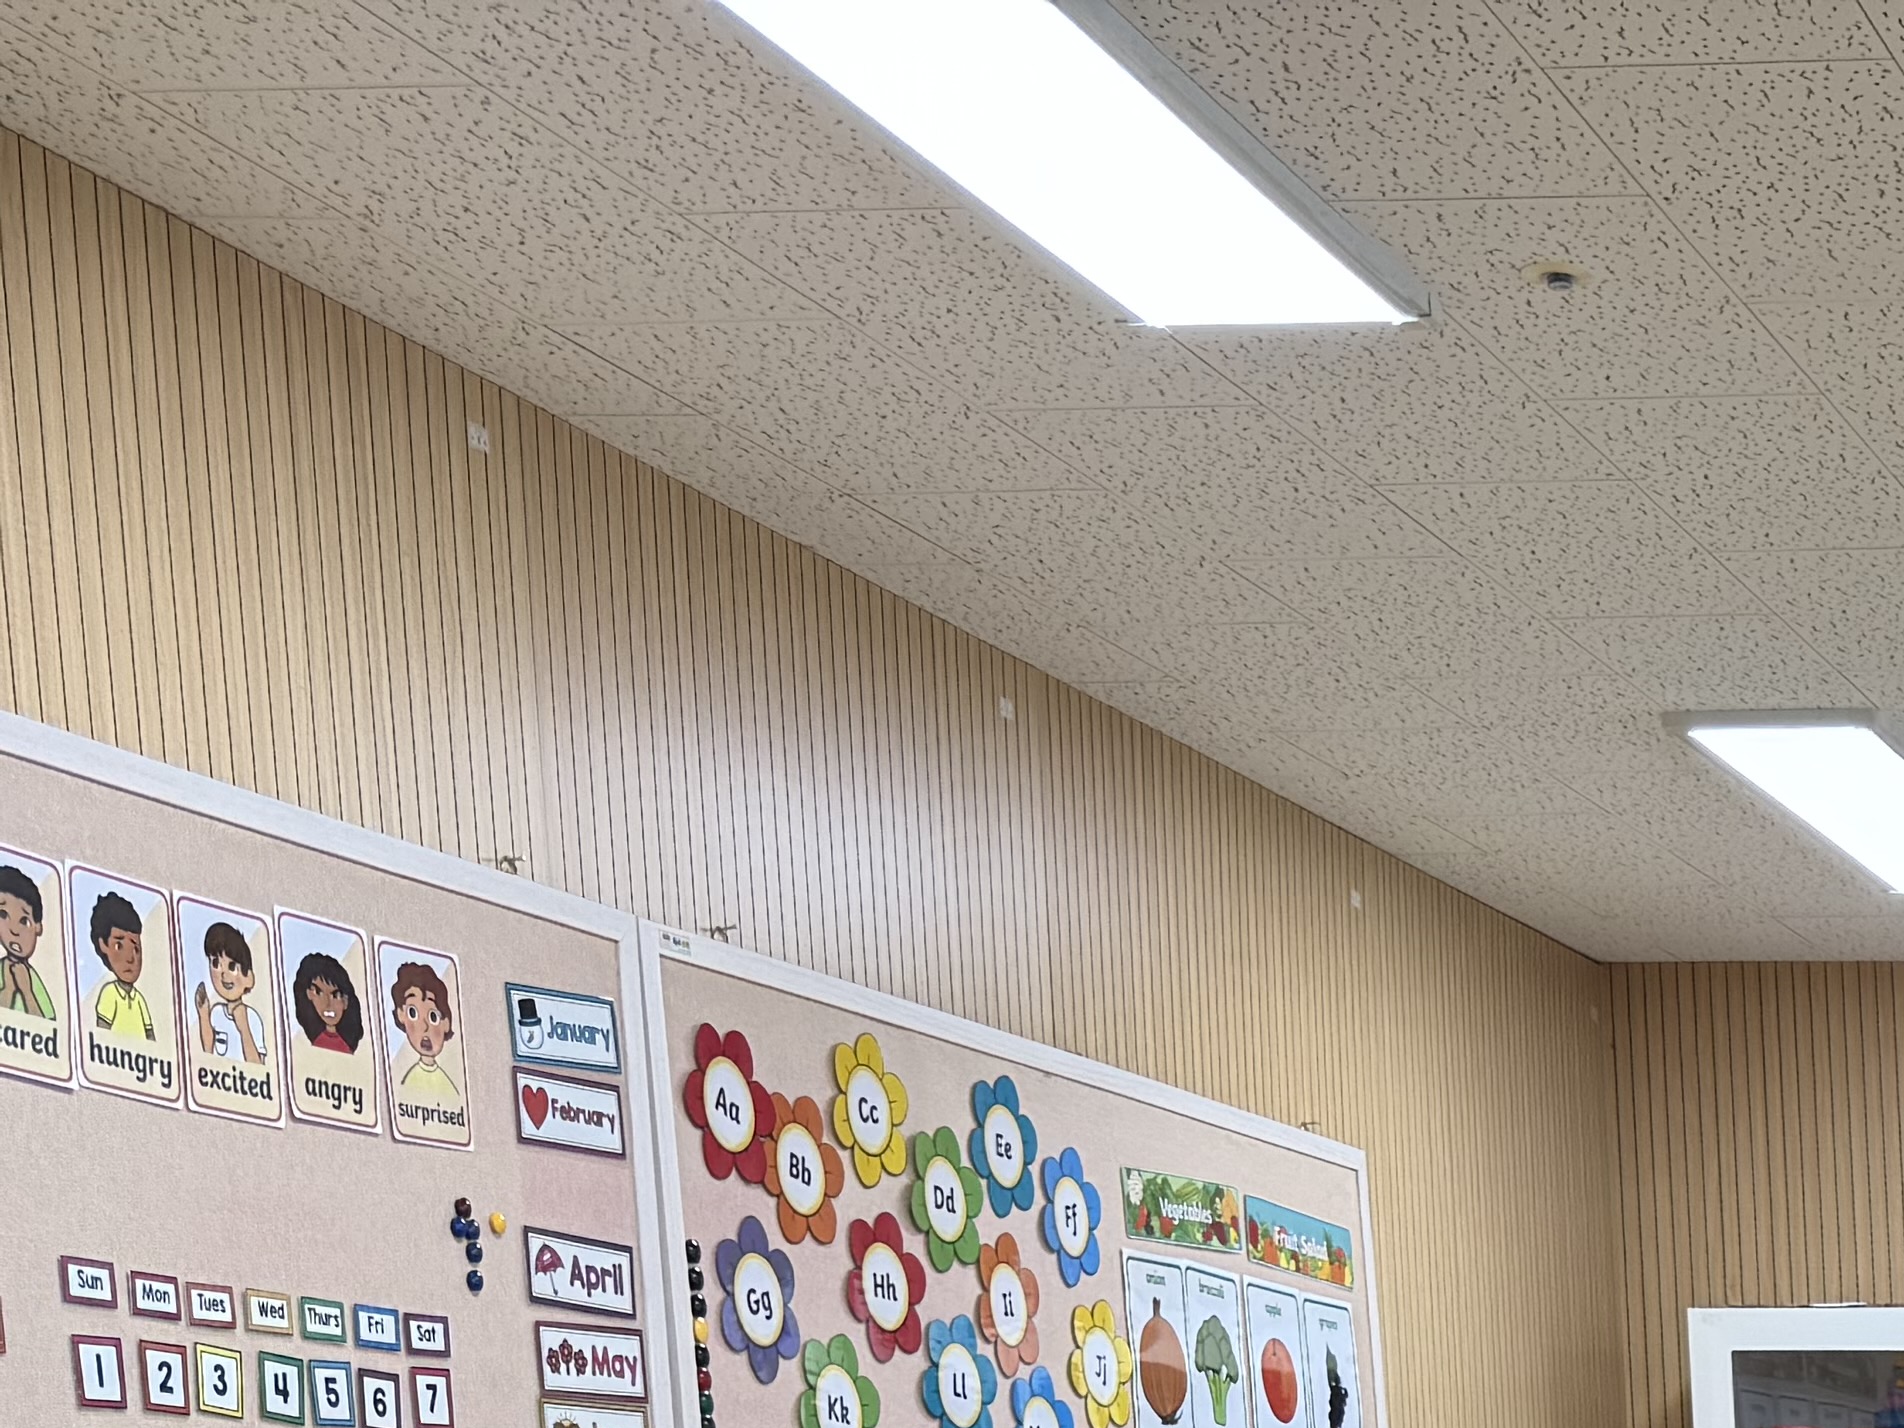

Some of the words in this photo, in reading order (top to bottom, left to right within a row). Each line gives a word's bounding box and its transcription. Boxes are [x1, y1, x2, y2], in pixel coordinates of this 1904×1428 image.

[0, 1025, 59, 1059] ared
[547, 1016, 609, 1052] January
[88, 1031, 173, 1087] hungry
[197, 1065, 273, 1101] excited
[304, 1077, 363, 1115] angry
[397, 1102, 466, 1129] surprised
[551, 1098, 615, 1134] February
[714, 1087, 741, 1125] Aa
[858, 1096, 879, 1124] Cc
[995, 1133, 1013, 1160] Ee
[789, 1151, 812, 1187] Bb
[933, 1185, 957, 1214] Dd
[1159, 1197, 1212, 1224] Vegetables
[1064, 1203, 1077, 1237] Ff
[1274, 1227, 1298, 1251] Fruit
[570, 1255, 624, 1297] April
[872, 1272, 898, 1302] Hh
[77, 1269, 104, 1291] Sun
[142, 1283, 171, 1304] Mon
[196, 1293, 226, 1314] Tues
[257, 1300, 285, 1320] Wed
[307, 1306, 341, 1329] Thurs
[367, 1315, 385, 1335] Fri
[416, 1324, 436, 1343] Sat
[746, 1288, 773, 1321] Gg
[1002, 1291, 1015, 1318] Ii
[592, 1345, 637, 1387] May
[1095, 1354, 1107, 1387] Jj
[95, 1353, 105, 1388] 1
[157, 1360, 174, 1395] 2
[212, 1363, 228, 1397] 3
[273, 1372, 290, 1404] 4
[324, 1376, 340, 1408] 5
[372, 1387, 387, 1418] 6
[425, 1383, 438, 1414] 7
[953, 1372, 968, 1400] Ll
[827, 1394, 851, 1426] Kk
